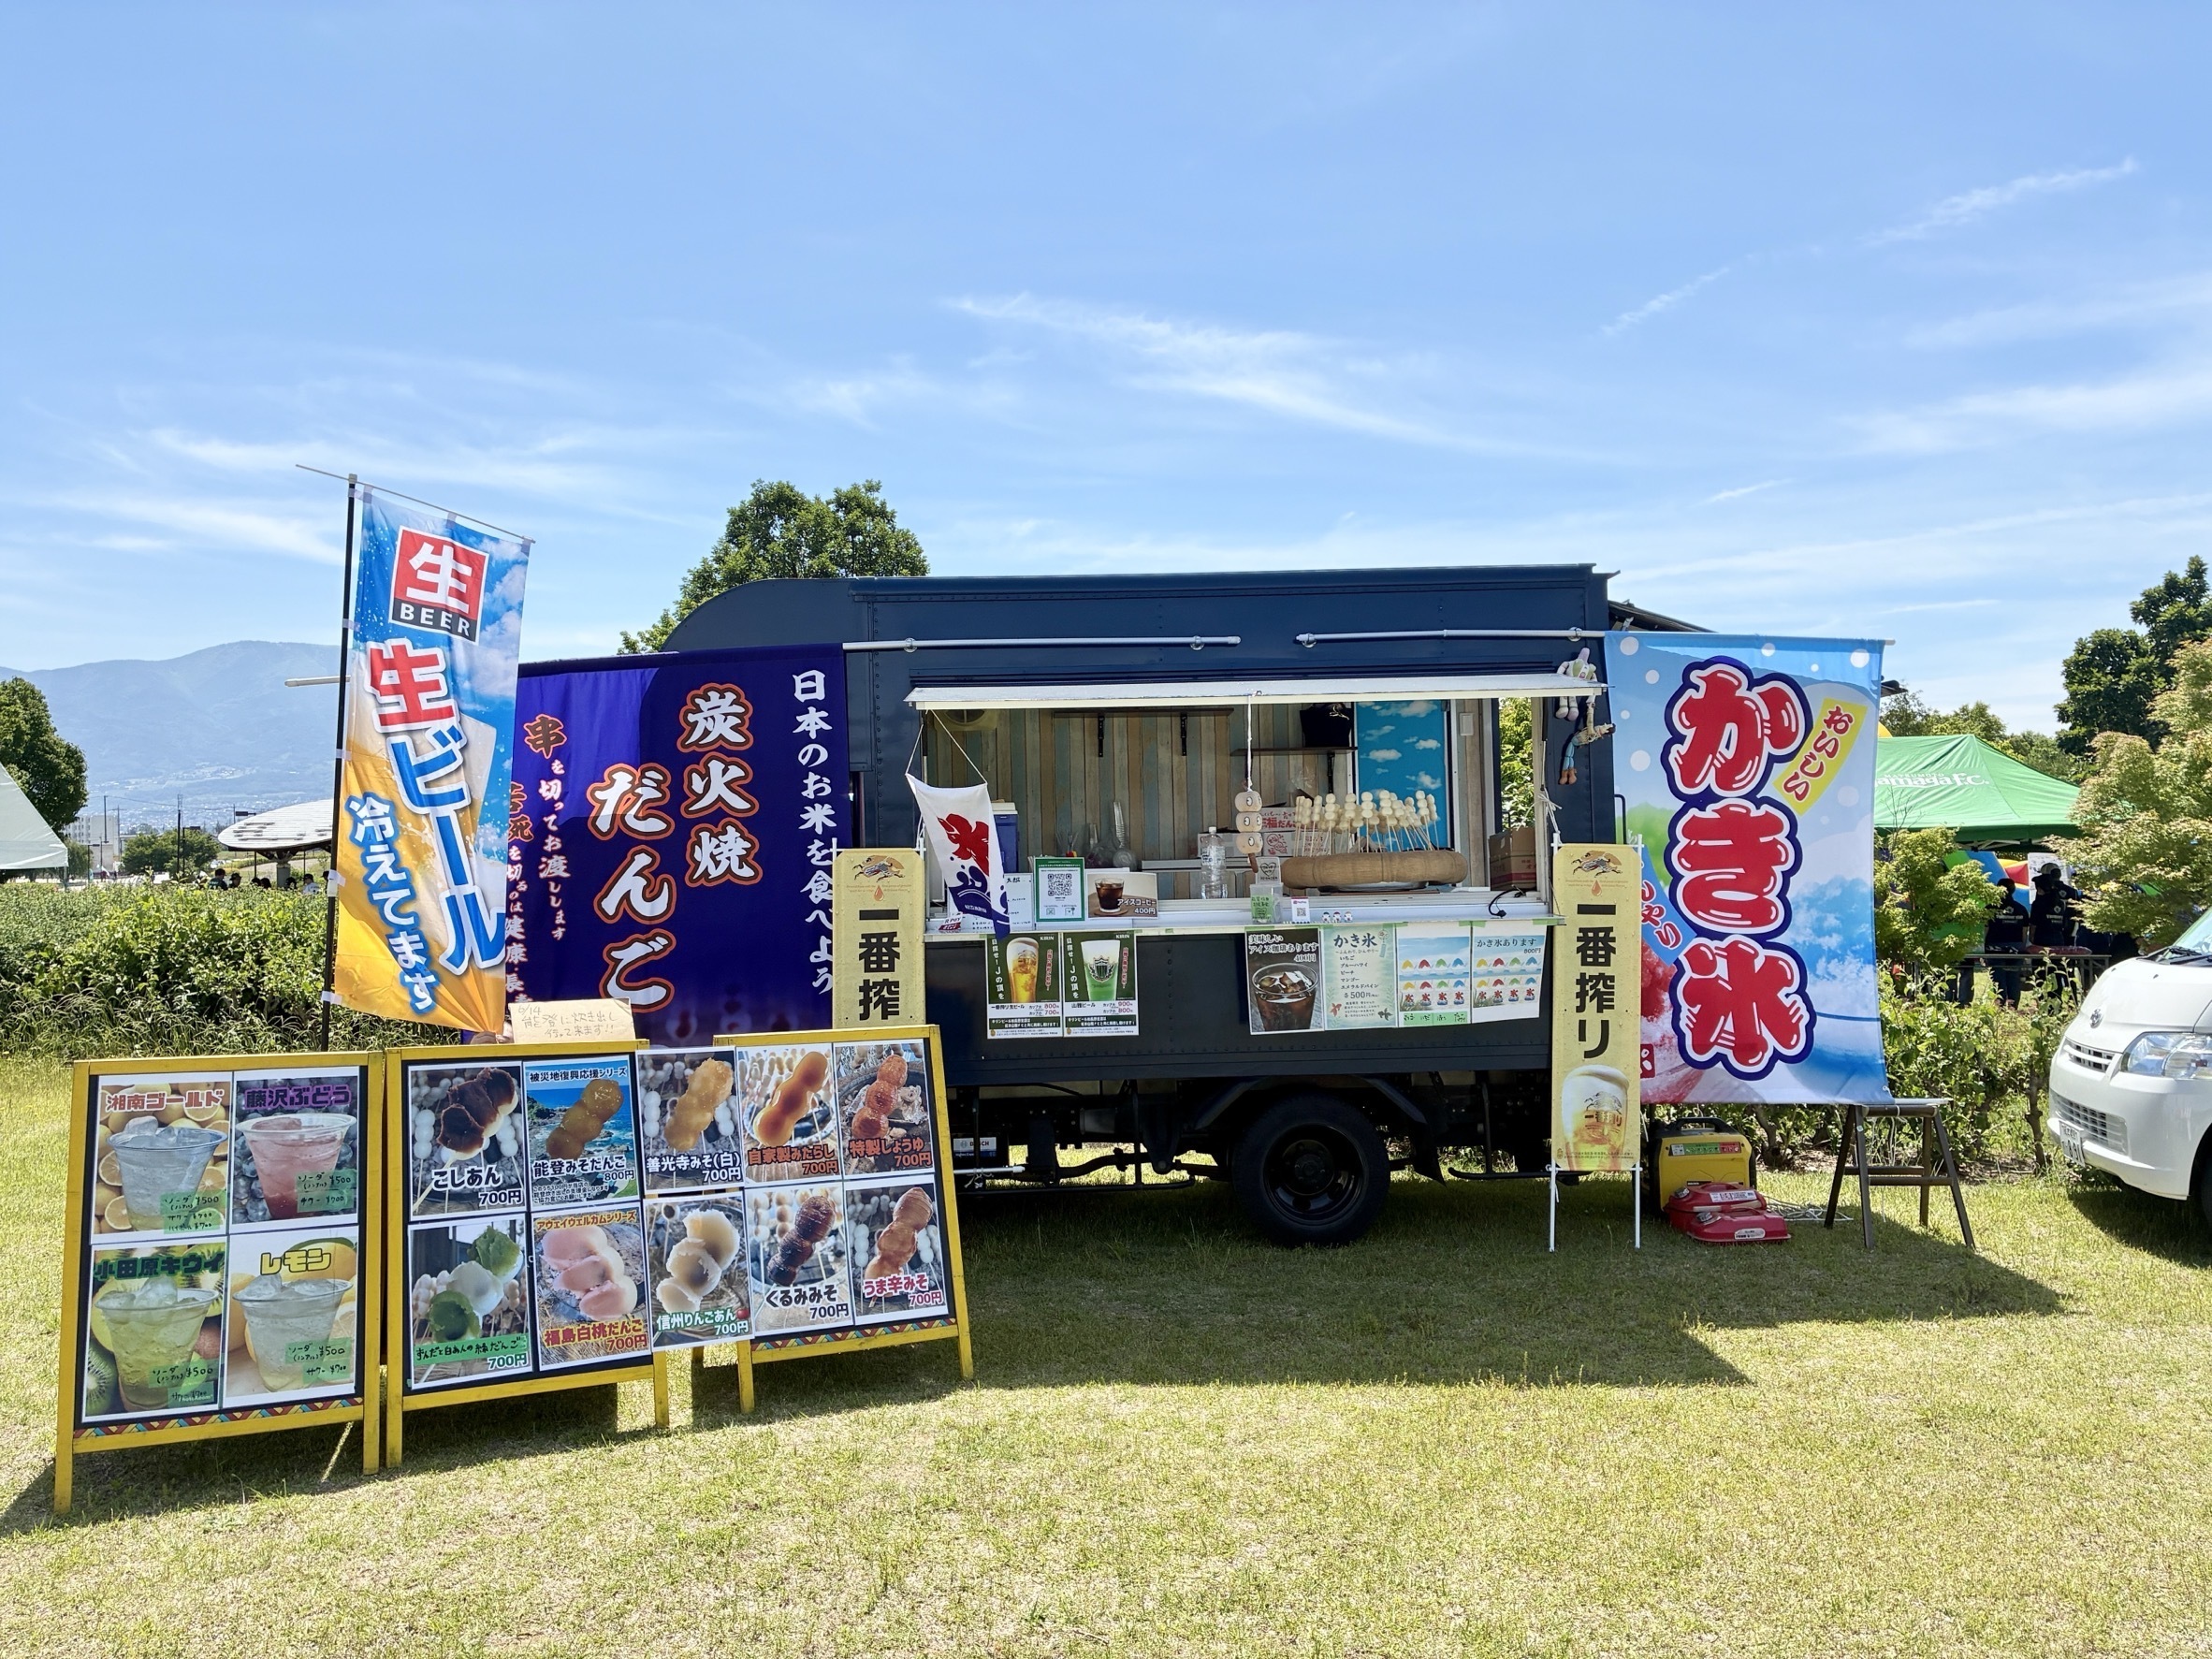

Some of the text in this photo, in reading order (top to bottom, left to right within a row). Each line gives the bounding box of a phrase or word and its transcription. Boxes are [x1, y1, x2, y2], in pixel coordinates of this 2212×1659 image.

[406, 543, 472, 613] 生
[400, 604, 473, 637] BEER
[1783, 705, 1853, 802] おいしい
[678, 686, 761, 884] 炭火焼
[1875, 776, 1953, 788] amaga
[369, 642, 505, 969] 生ビール
[524, 714, 570, 940] 串を切ってお渡しします
[793, 670, 836, 995] 日本のお米を食べよう
[1666, 660, 1813, 1076] かき氷
[589, 765, 675, 1011] だんご
[350, 796, 438, 1011] 冷えてます
[1333, 932, 1378, 948] かき氷
[1477, 938, 1536, 948] かき氷あります
[1293, 953, 1317, 963] 400円
[1576, 904, 1616, 1059] 一番搾り
[530, 1067, 627, 1083] 被災地復興応援シリーズ
[106, 1089, 225, 1112] 湘南ゴールド
[244, 1084, 352, 1110] 藤沢ぶどう
[748, 1143, 835, 1166] 自家製みたらし
[849, 1137, 924, 1158] 特製しょうゆ
[532, 1156, 626, 1179] 能登みそだんご
[646, 1150, 741, 1173] 善光寺みそ(白)
[802, 1159, 839, 1176] 700円
[895, 1151, 934, 1168] 700円
[298, 1171, 325, 1183] ソーダ
[431, 1164, 502, 1190] こしあん
[604, 1170, 635, 1183] 800円
[702, 1168, 742, 1184] 700円
[165, 1195, 192, 1204] ソーダ
[479, 1189, 523, 1206] 700円
[535, 1210, 637, 1231] アウェイウェルカムシリーズ
[95, 1252, 225, 1280] 小田原キウイ
[259, 1248, 332, 1276] レモン
[863, 1272, 929, 1298] うま辛みそ
[765, 1285, 838, 1309] くるみみそ
[909, 1291, 943, 1307] 700円
[656, 1307, 737, 1332] 信州りんごあん
[809, 1302, 851, 1321] 700円
[543, 1318, 643, 1347] 福島白桃だんご
[714, 1318, 749, 1336] 700円
[289, 1342, 313, 1354] ソーダ
[606, 1334, 648, 1352] 700円
[153, 1365, 179, 1375] ソーダ
[488, 1353, 528, 1370] 700円
